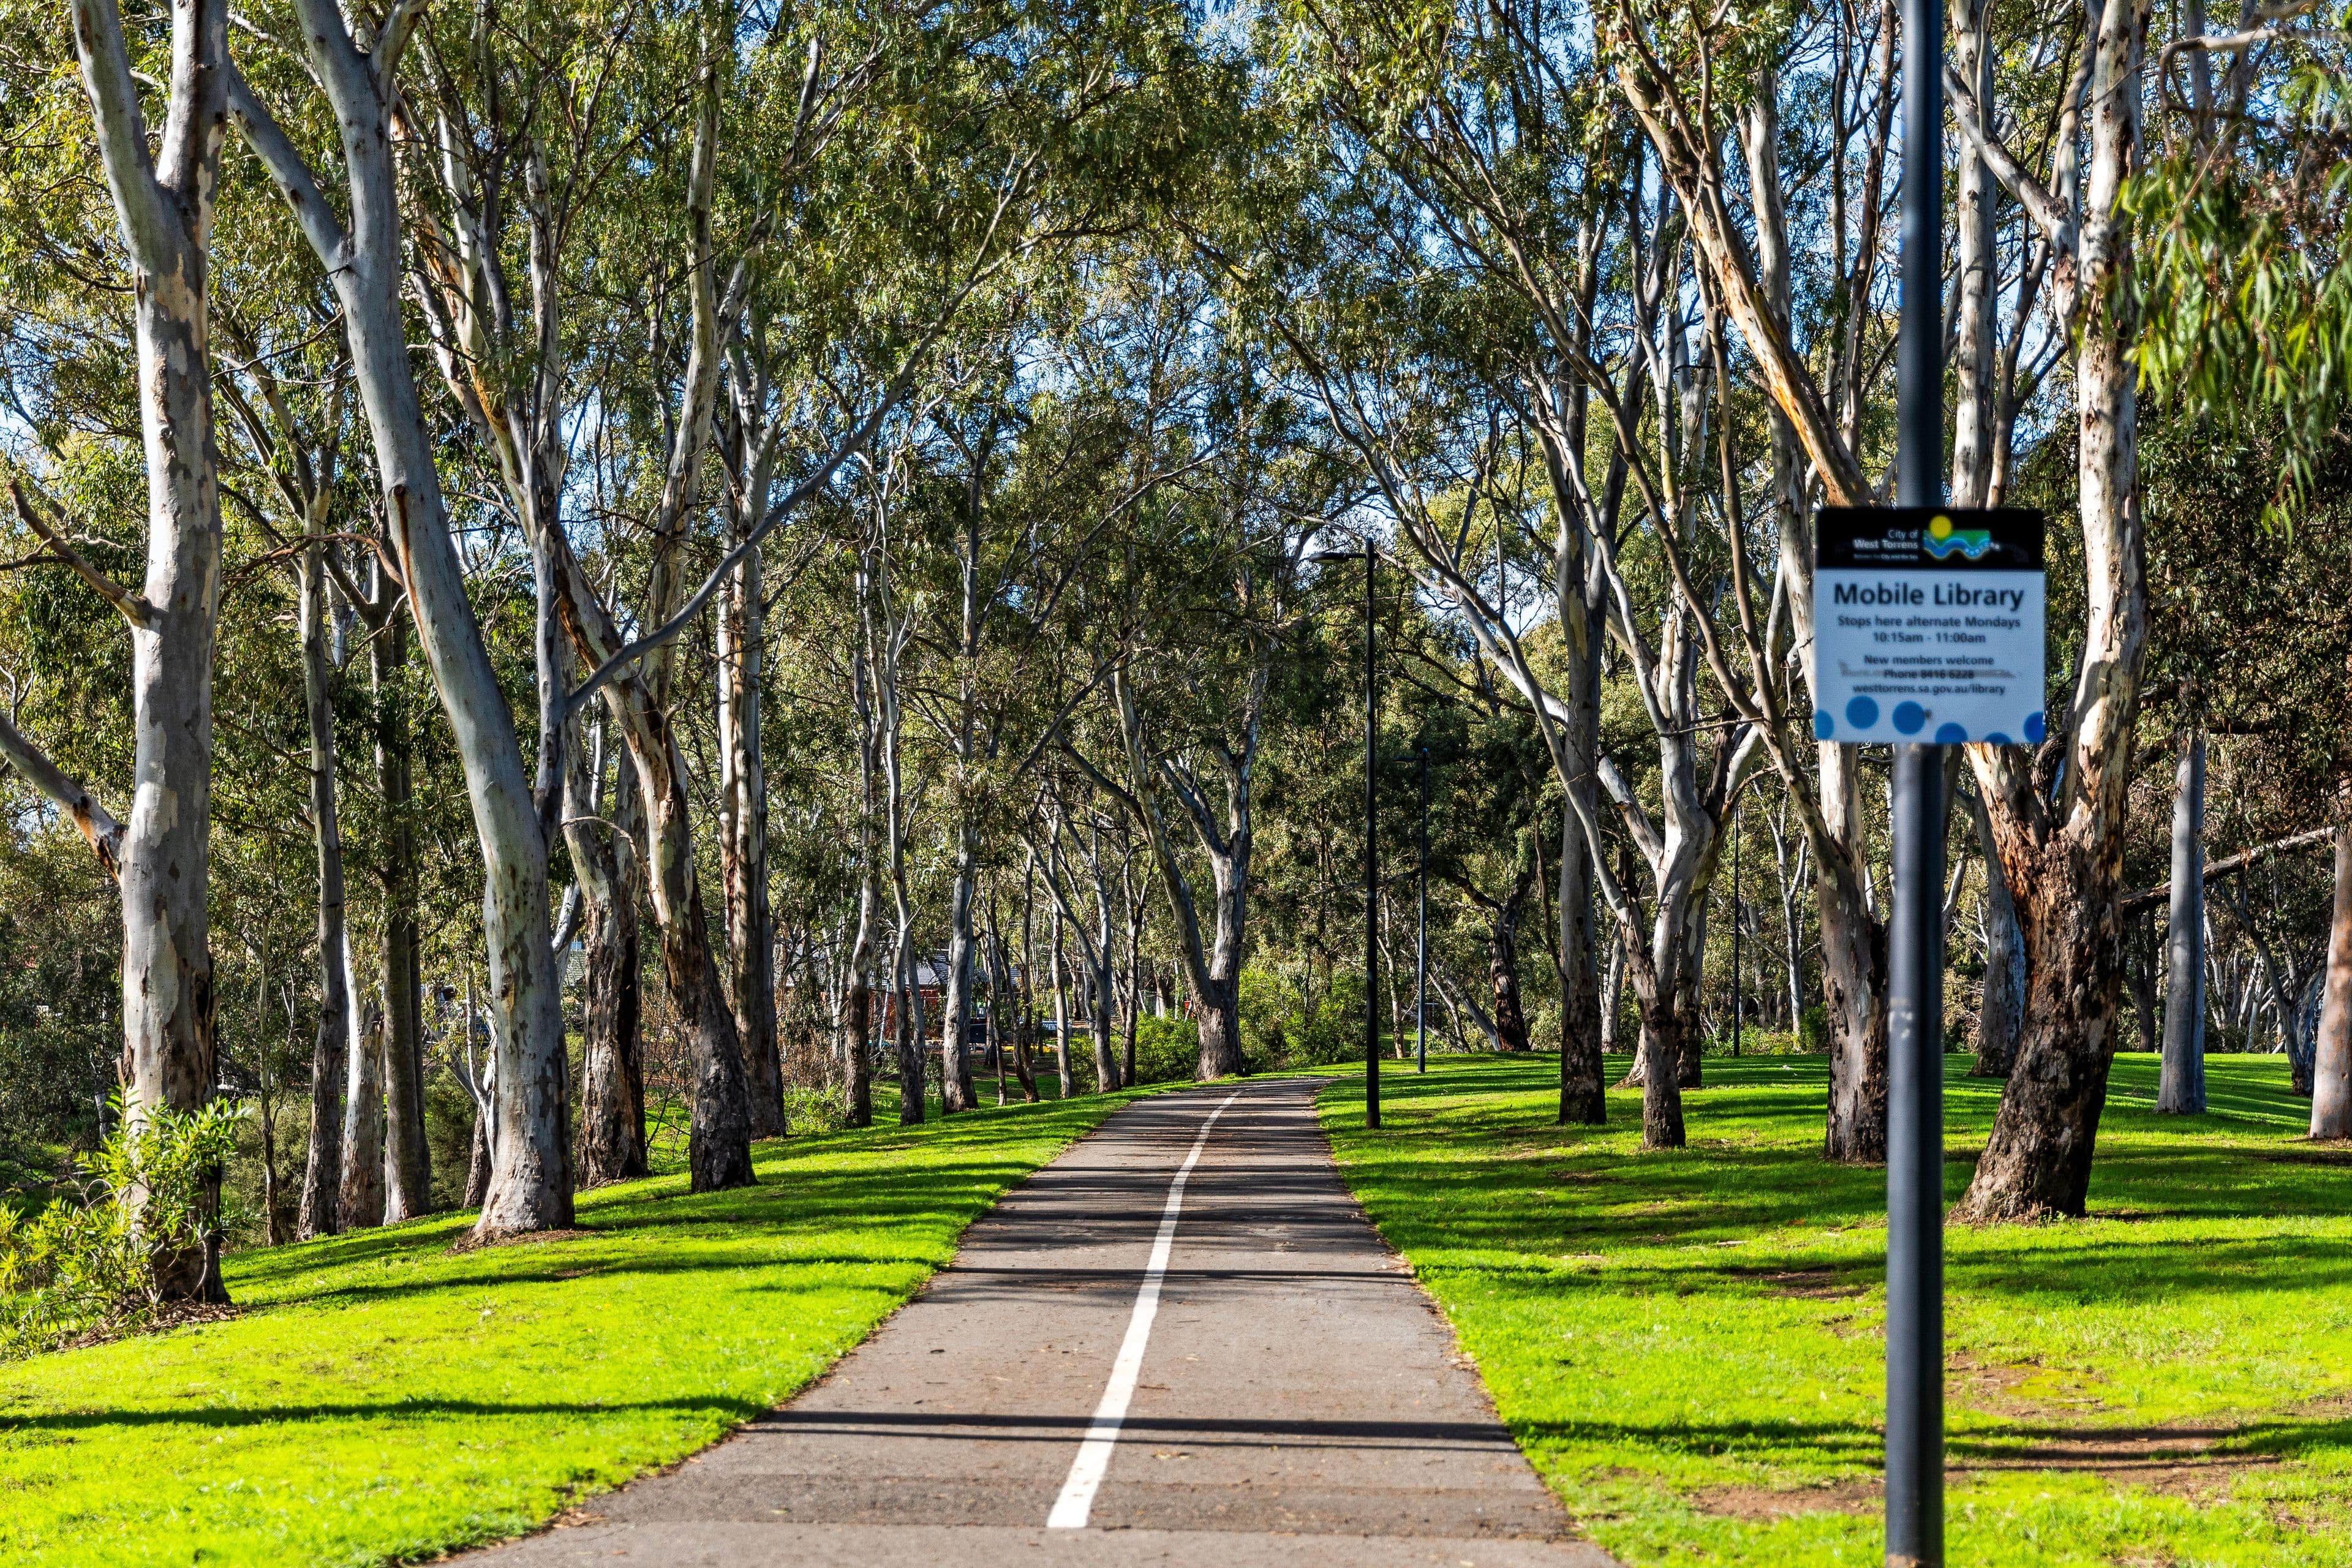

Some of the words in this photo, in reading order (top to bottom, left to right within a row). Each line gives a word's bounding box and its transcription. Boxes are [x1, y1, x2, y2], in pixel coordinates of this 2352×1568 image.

[1888, 529, 1906, 540] City
[1910, 529, 1918, 538] of
[1853, 540, 1879, 549] West
[1882, 540, 1918, 549] Torrens
[1834, 582, 1924, 605] Mobile
[1934, 582, 2024, 611] Library
[1838, 616, 1871, 628] Stops
[1875, 615, 1902, 626] here
[1906, 616, 1961, 627] alternate
[1965, 616, 2021, 629] Mondays
[1874, 631, 1924, 643] 10:15am
[1936, 631, 1986, 643] 11:00am
[1864, 655, 1888, 665] New
[1893, 655, 1942, 665] members
[1946, 655, 1994, 665] welcome
[1884, 669, 1917, 679] Phone
[1853, 684, 2005, 695] westtorrens.sa.gov.au/library
